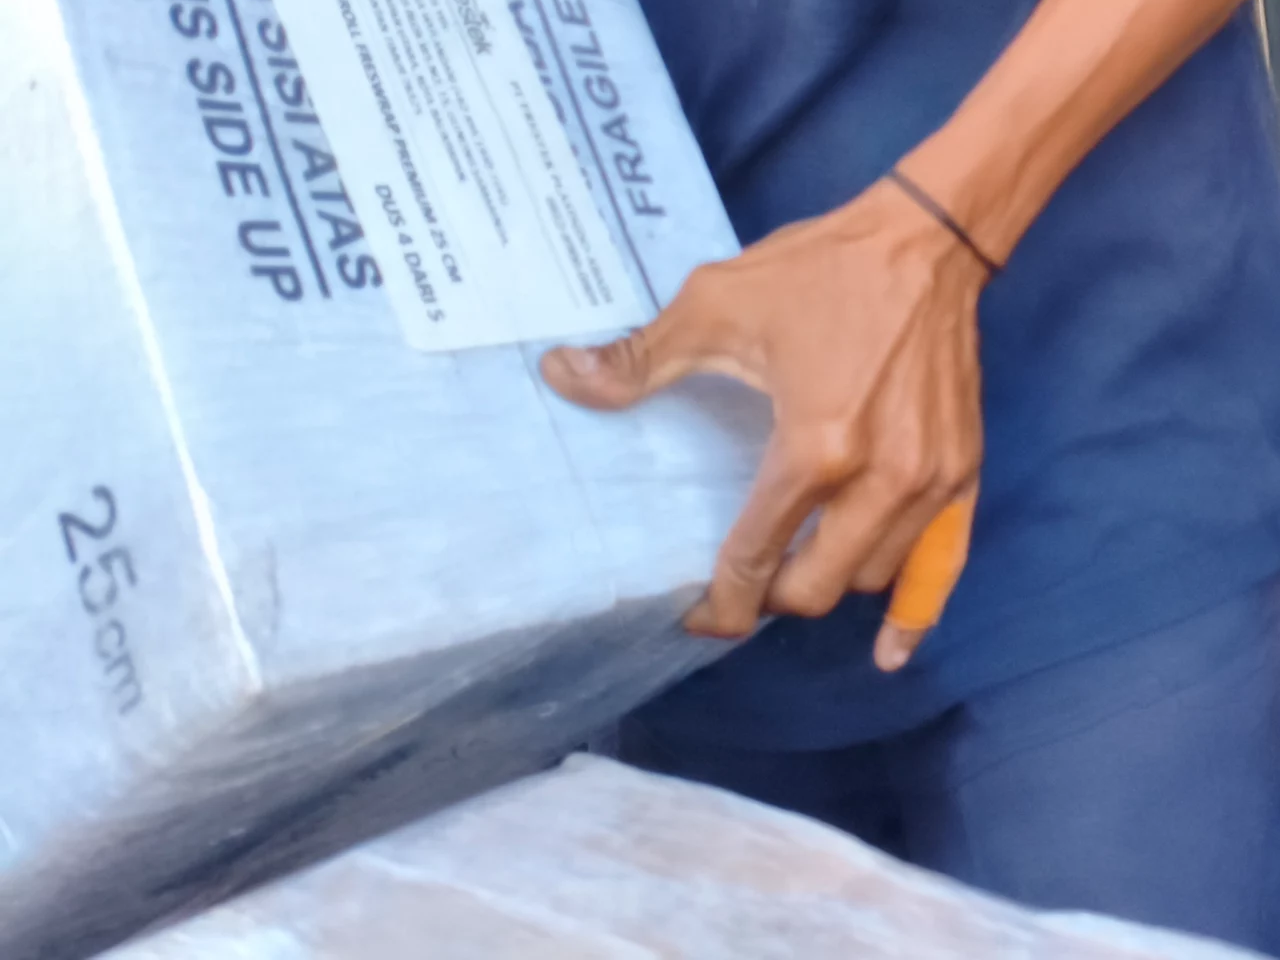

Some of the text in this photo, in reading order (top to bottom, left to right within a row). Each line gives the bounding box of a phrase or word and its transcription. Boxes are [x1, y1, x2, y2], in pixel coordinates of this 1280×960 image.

[186, 58, 271, 198] SIDE
[237, 220, 304, 303] UP
[256, 18, 320, 125] SISI
[291, 139, 384, 291] ATAS
[335, 0, 364, 39] ROLL
[353, 44, 402, 133] FRESWRAP
[391, 139, 440, 223] PREMIUM
[428, 228, 449, 249] 25
[439, 253, 463, 284] CM
[373, 184, 406, 227] DUS
[402, 252, 439, 305] DARI
[58, 485, 143, 716] 25cm
